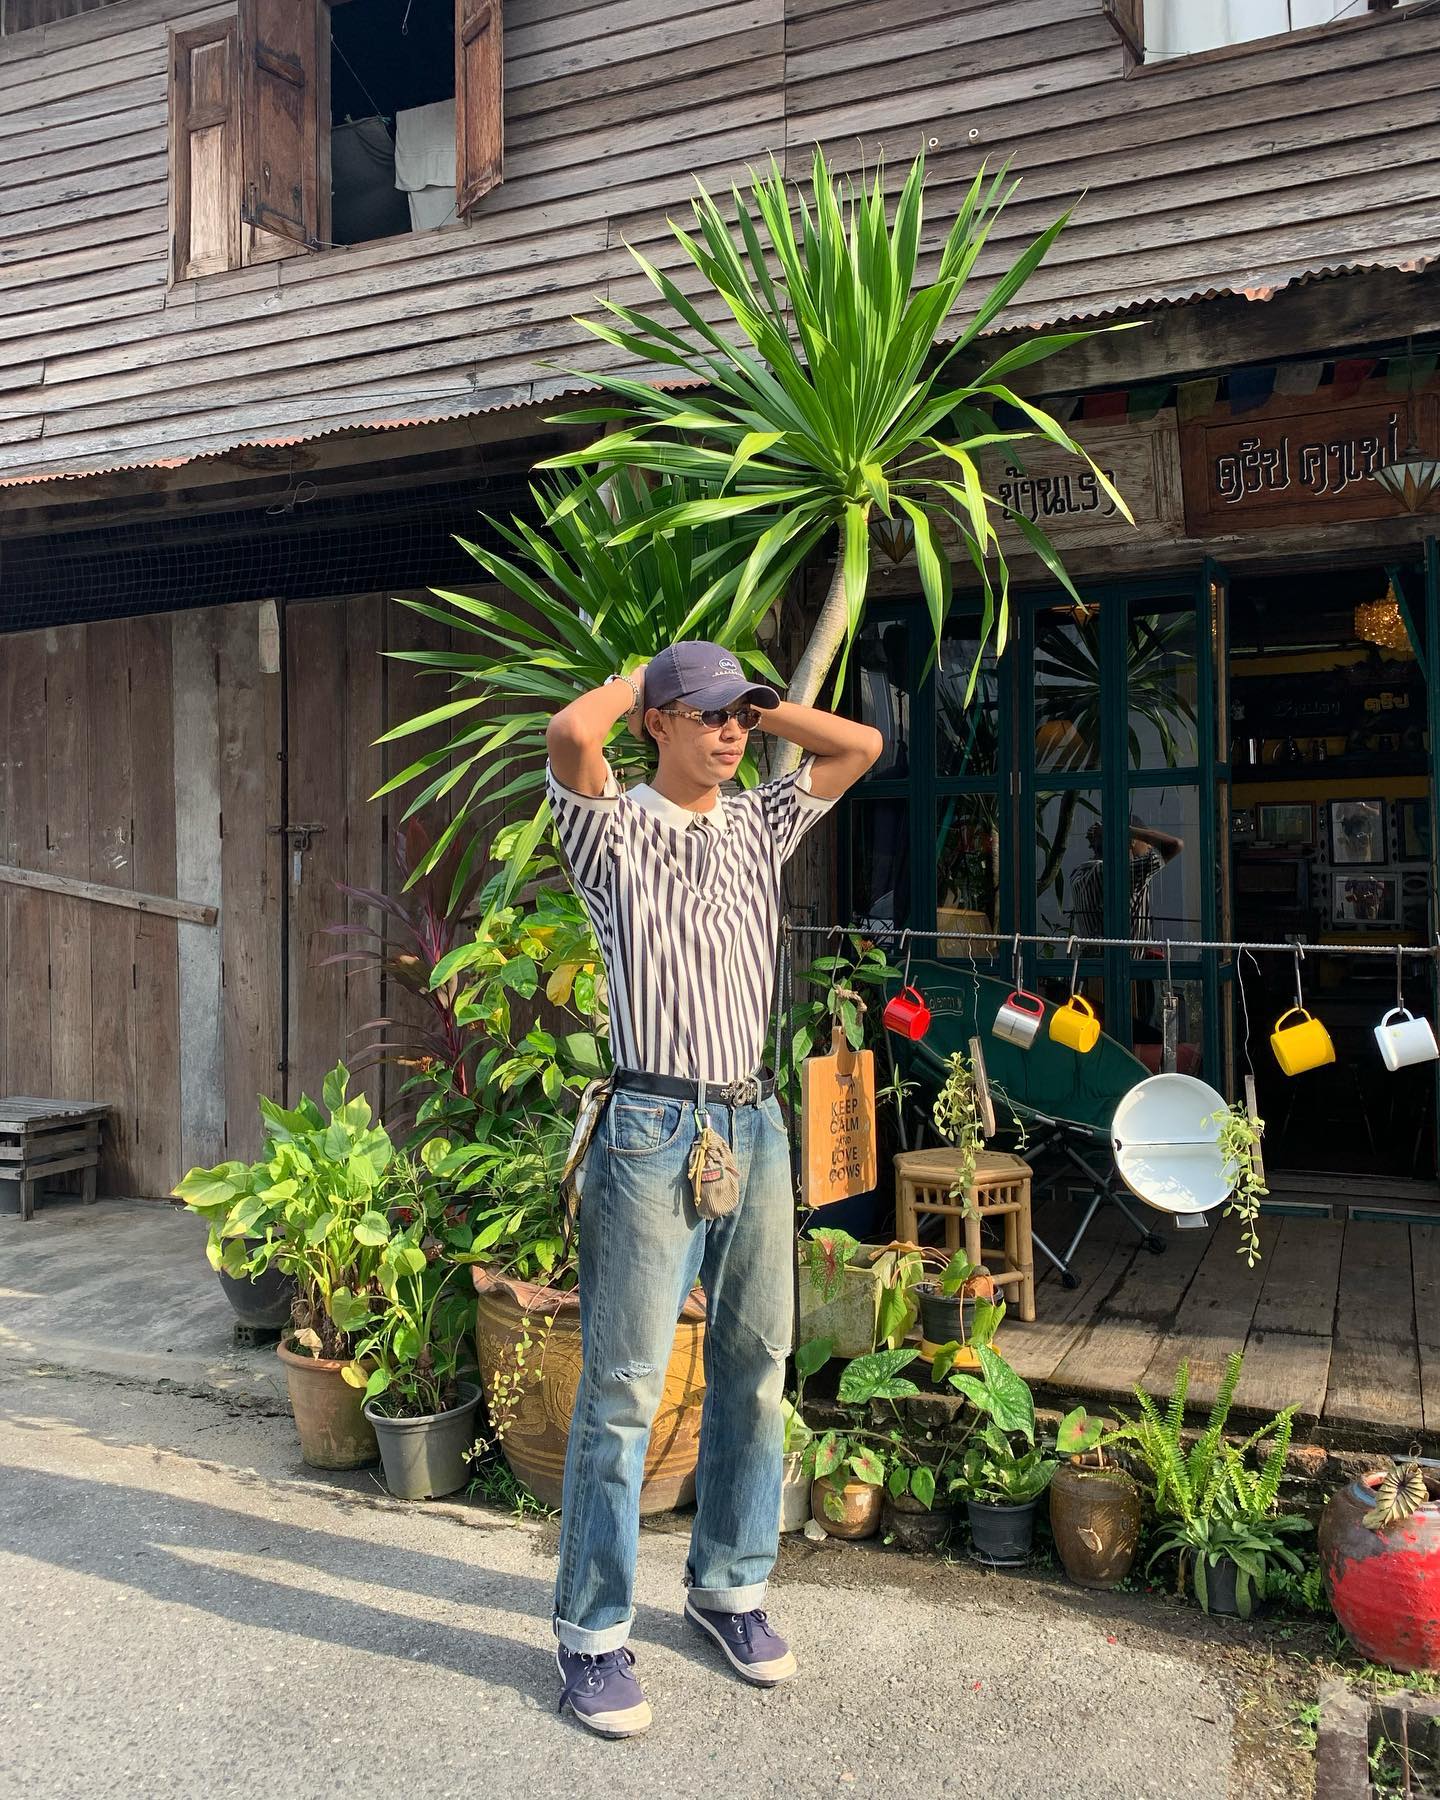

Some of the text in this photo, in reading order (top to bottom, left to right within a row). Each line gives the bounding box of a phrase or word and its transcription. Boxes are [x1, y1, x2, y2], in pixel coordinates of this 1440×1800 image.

[1216, 433, 1292, 505] ดริป
[831, 1098, 859, 1117] KEEP
[829, 1116, 860, 1135] CALM
[831, 1146, 858, 1166] LOVE
[829, 1163, 861, 1184] COWS
